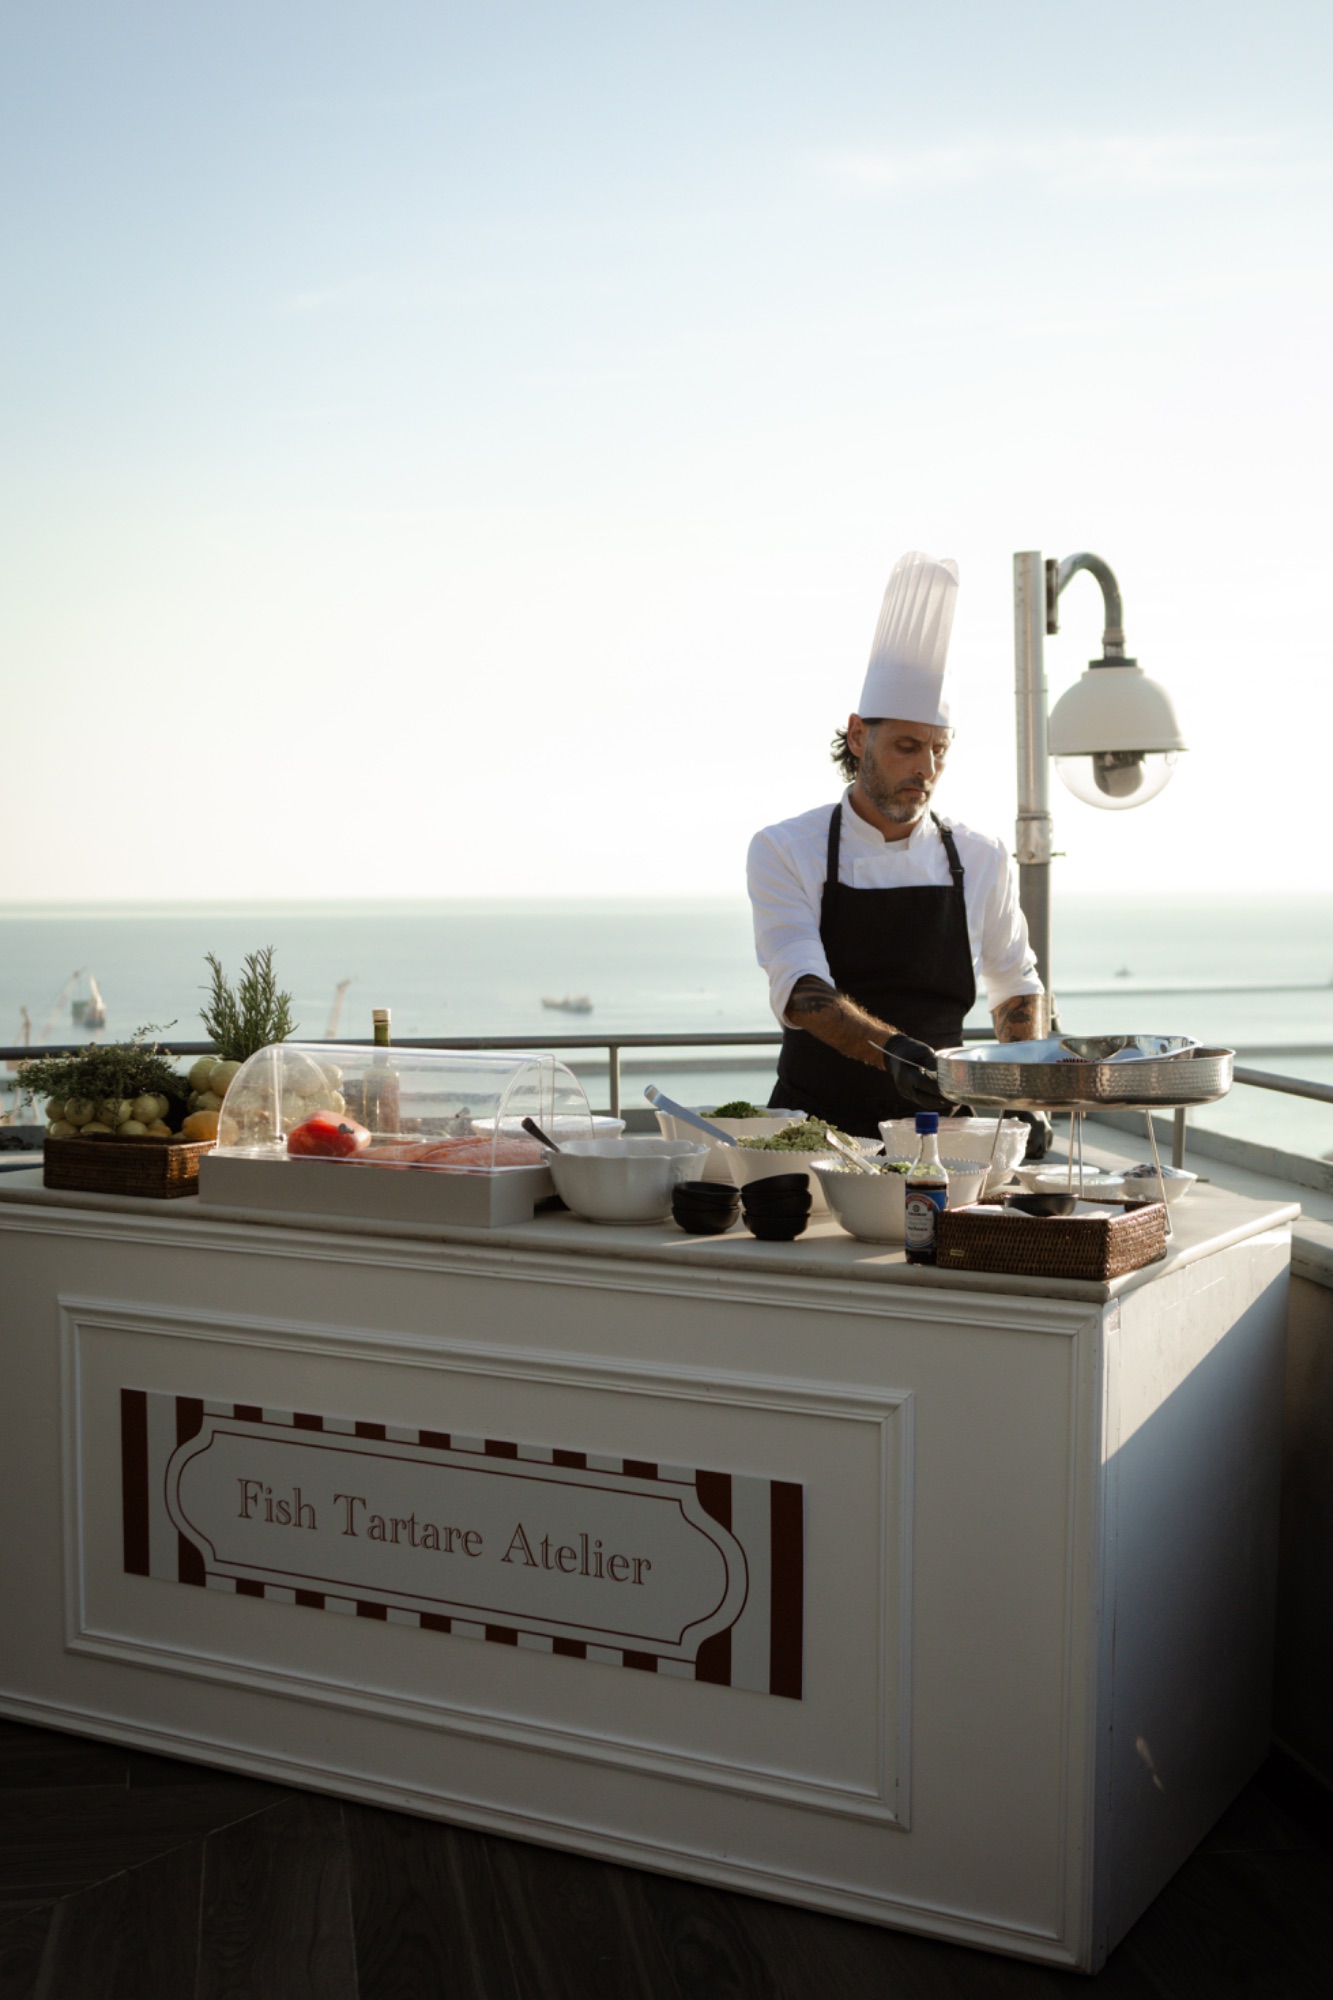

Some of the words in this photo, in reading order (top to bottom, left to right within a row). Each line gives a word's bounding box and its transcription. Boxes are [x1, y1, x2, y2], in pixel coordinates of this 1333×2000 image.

[237, 1478, 317, 1531] Fish
[333, 1493, 483, 1557] Tartare
[501, 1522, 652, 1586] Atelier
